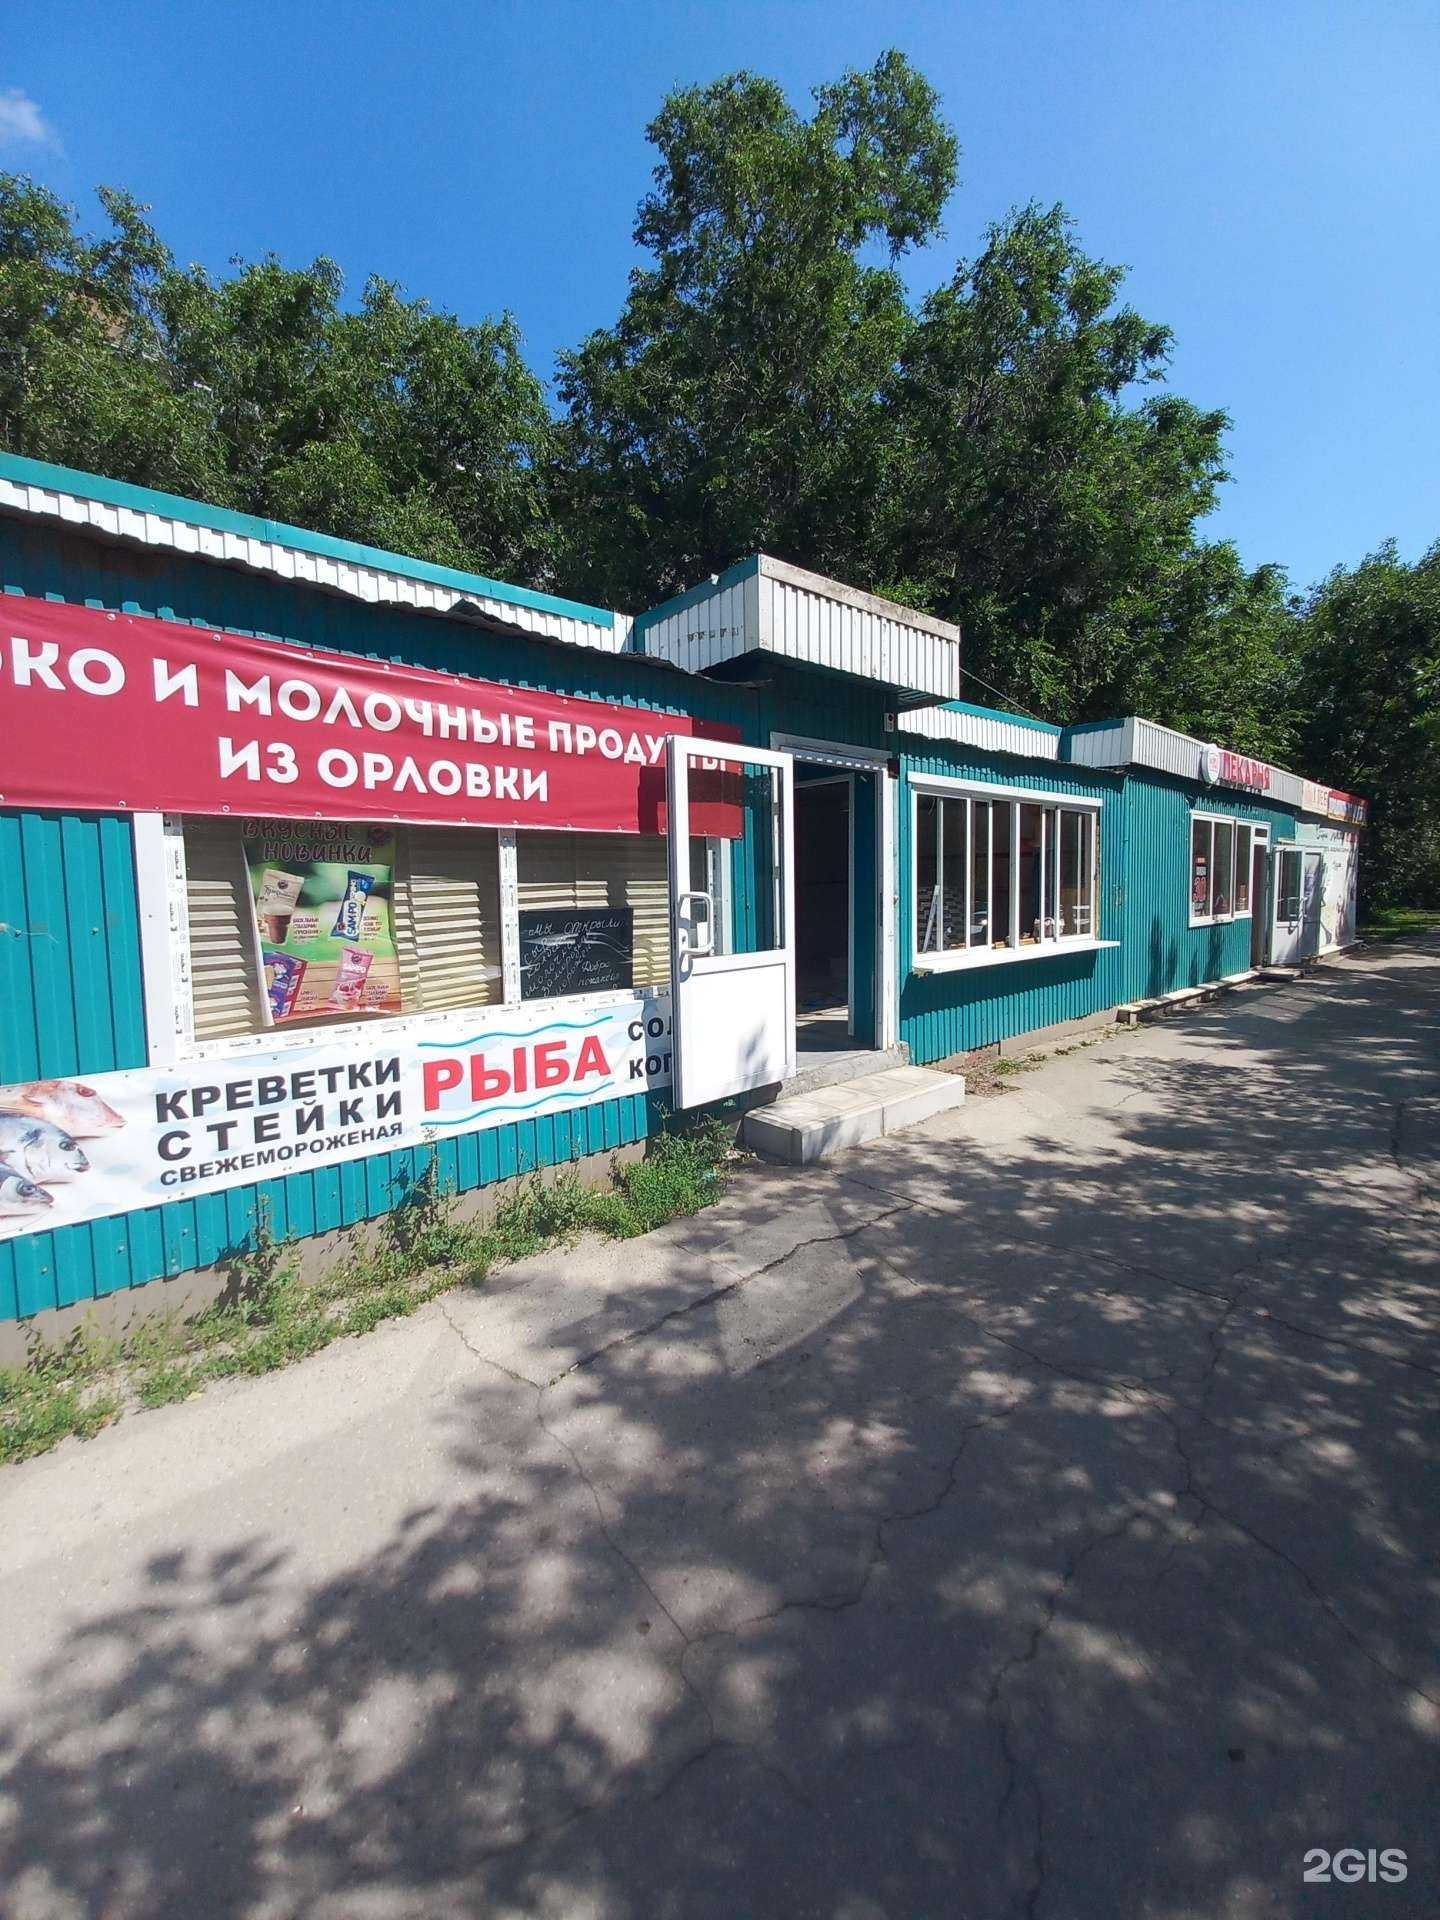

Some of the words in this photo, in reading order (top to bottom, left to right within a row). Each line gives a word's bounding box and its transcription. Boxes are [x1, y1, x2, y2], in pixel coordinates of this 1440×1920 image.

[0, 637, 126, 696] КО
[152, 657, 200, 707] И
[224, 668, 536, 749] МОЛОЧНЫЕ
[548, 720, 726, 772] ПРОДУ
[218, 736, 299, 784] ИЗ
[317, 748, 548, 802] ОРЛОВКИ
[263, 840, 372, 864] НОВИНКИ
[155, 1056, 401, 1124] КРЕВЕТКИ
[422, 1035, 612, 1113] РЫБА
[157, 1090, 402, 1162] СТЕЙКИ
[159, 1121, 403, 1187] СВЕЖЕМОРОЖЕНАЯ
